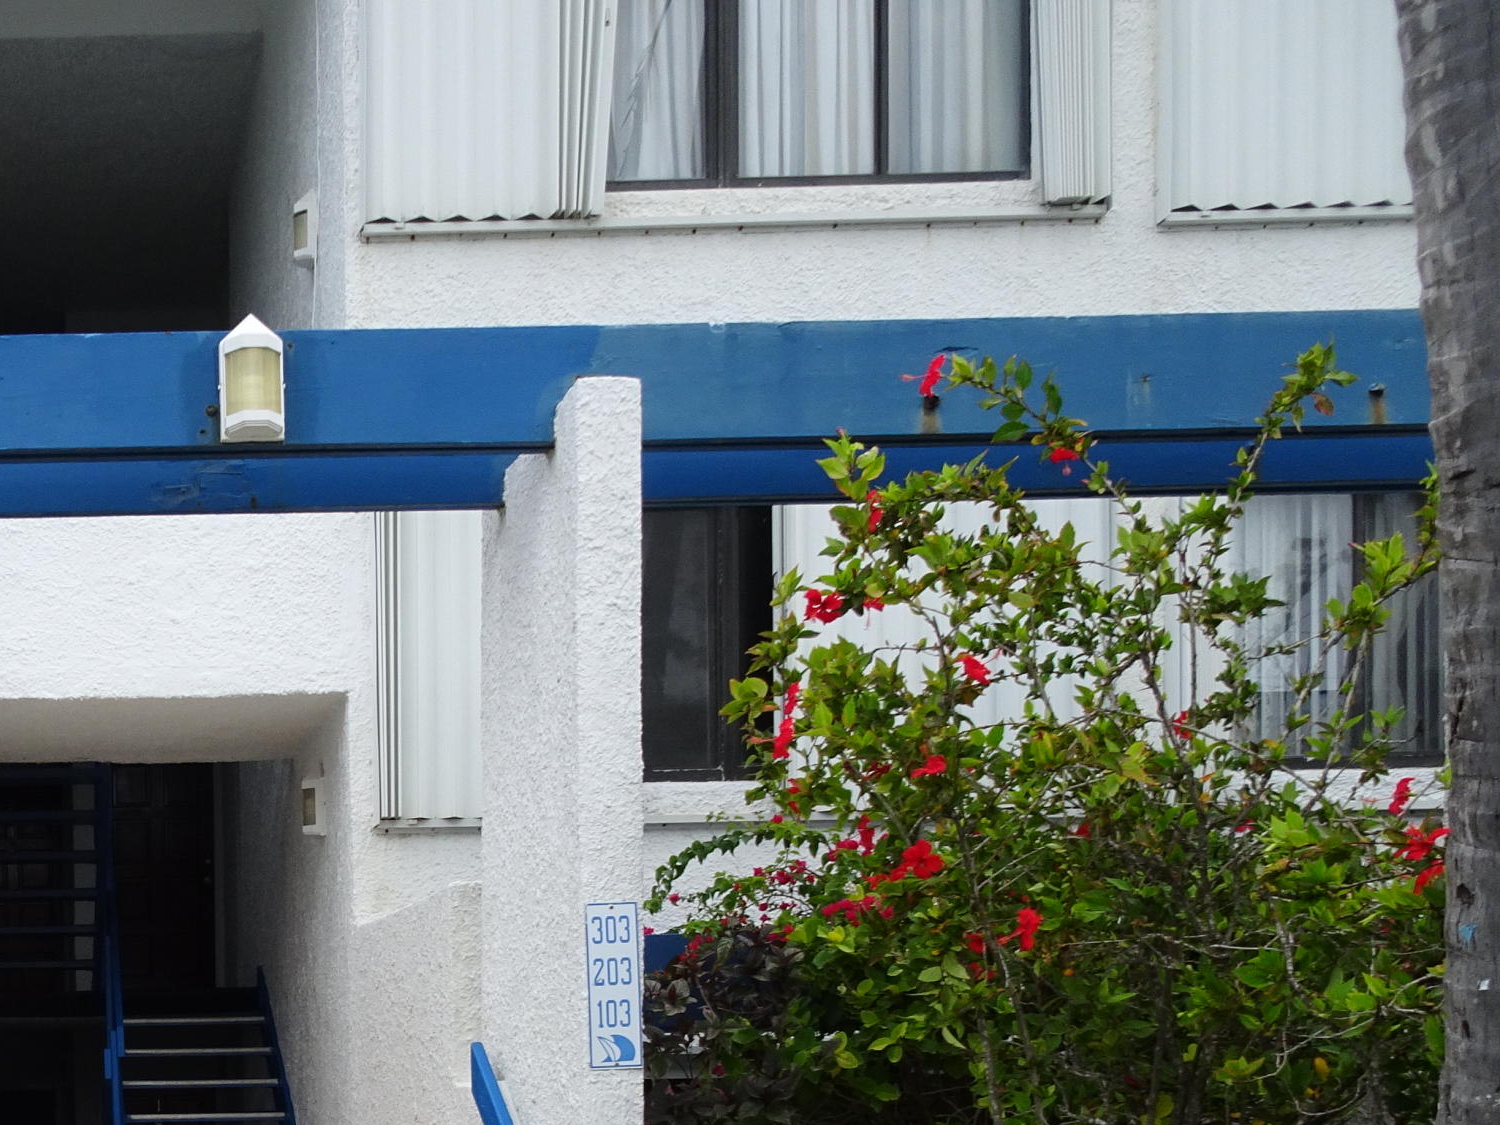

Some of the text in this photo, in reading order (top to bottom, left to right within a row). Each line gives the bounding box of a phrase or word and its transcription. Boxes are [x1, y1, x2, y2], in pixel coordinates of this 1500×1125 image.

[591, 915, 631, 944] 303
[593, 957, 632, 986] 203
[597, 999, 631, 1028] 103
